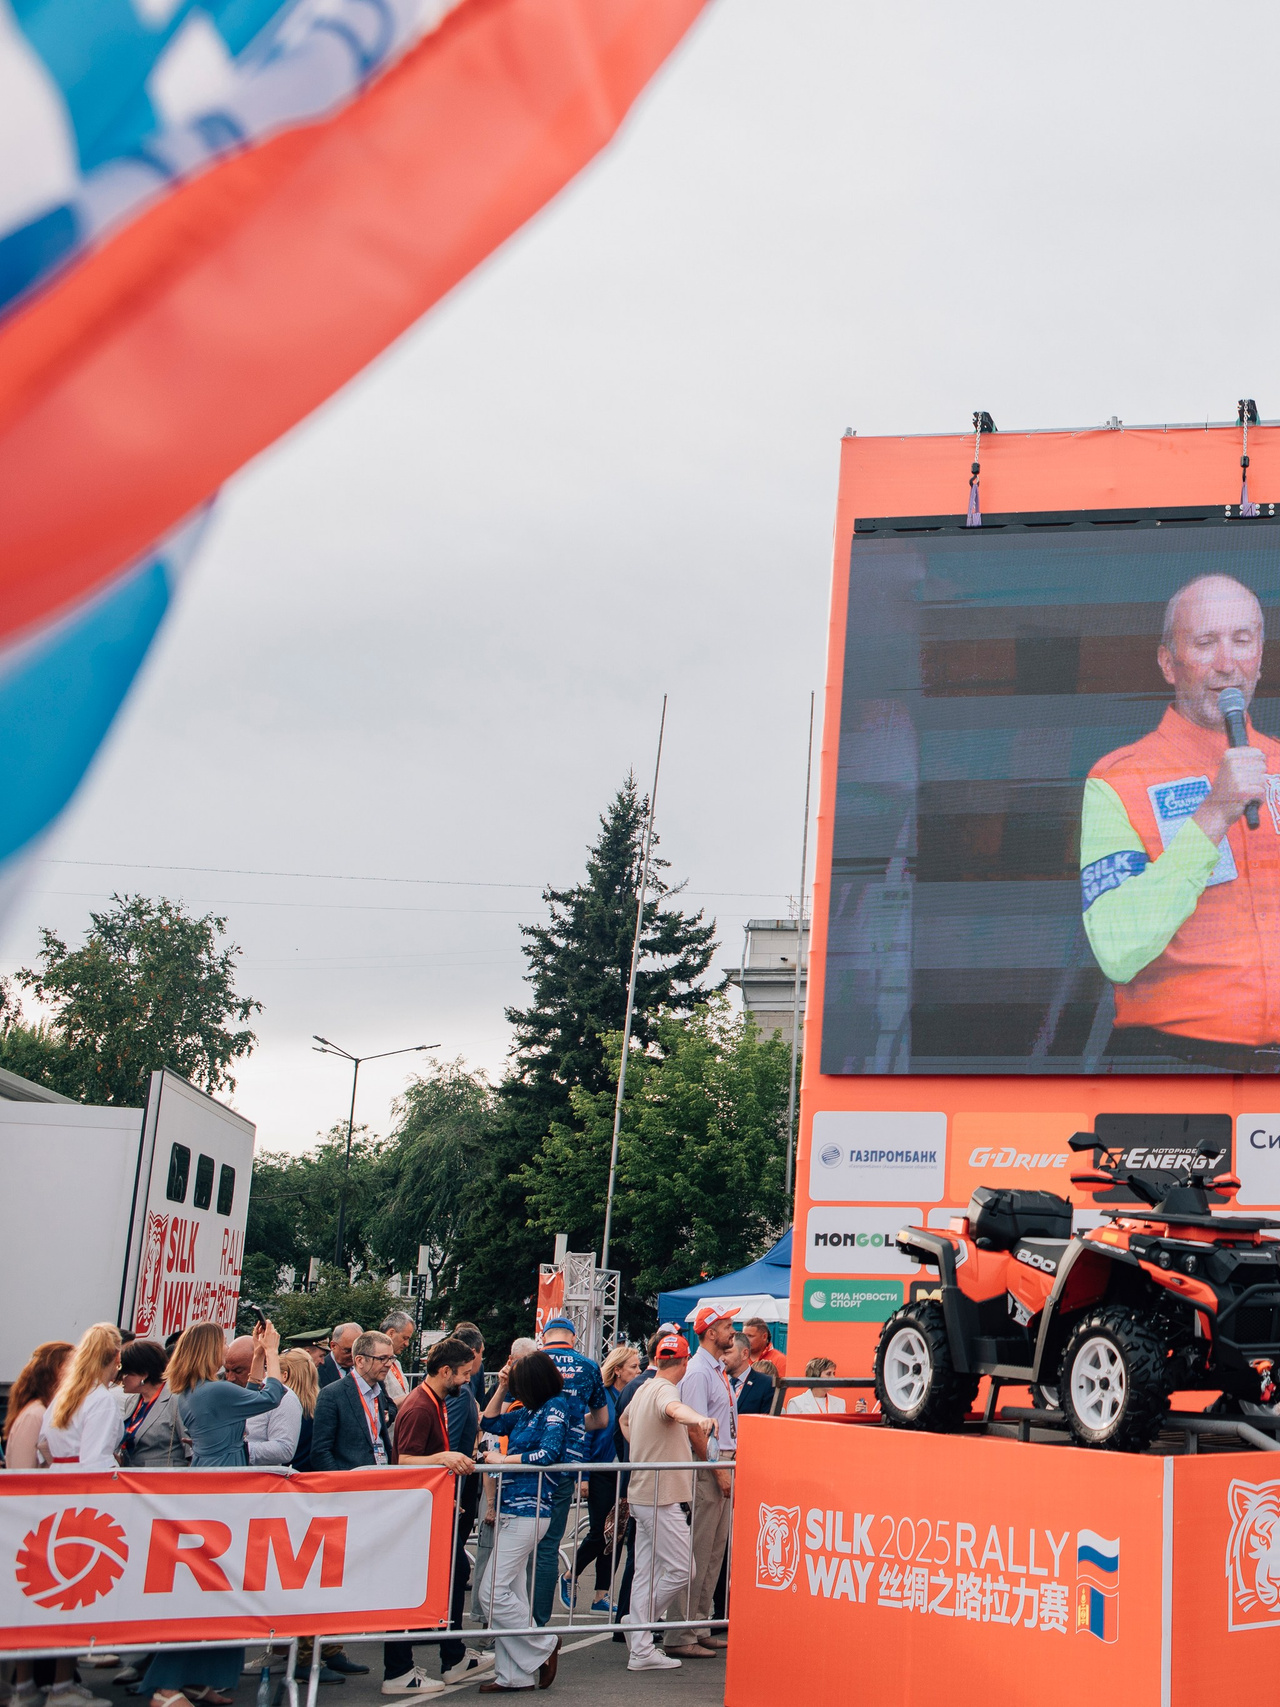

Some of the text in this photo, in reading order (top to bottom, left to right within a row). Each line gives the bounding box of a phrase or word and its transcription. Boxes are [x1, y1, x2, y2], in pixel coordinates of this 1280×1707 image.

[1082, 853, 1132, 888] SILK
[849, 1150, 937, 1163] ГАЗПРОМБАНК
[167, 1216, 199, 1274] SILK
[814, 1233, 899, 1247] MONGOL
[1016, 1248, 1057, 1273] 800
[162, 1281, 193, 1336] WAY
[830, 1292, 898, 1301] РИА НОВОСТИ
[830, 1300, 862, 1308] СПОРТ
[555, 1355, 574, 1363] VTB
[143, 1516, 348, 1594] RM
[805, 1507, 1071, 1578] SILK 2025 RALLY
[804, 1555, 1070, 1635] WAY 丝绸之路拉力赛
